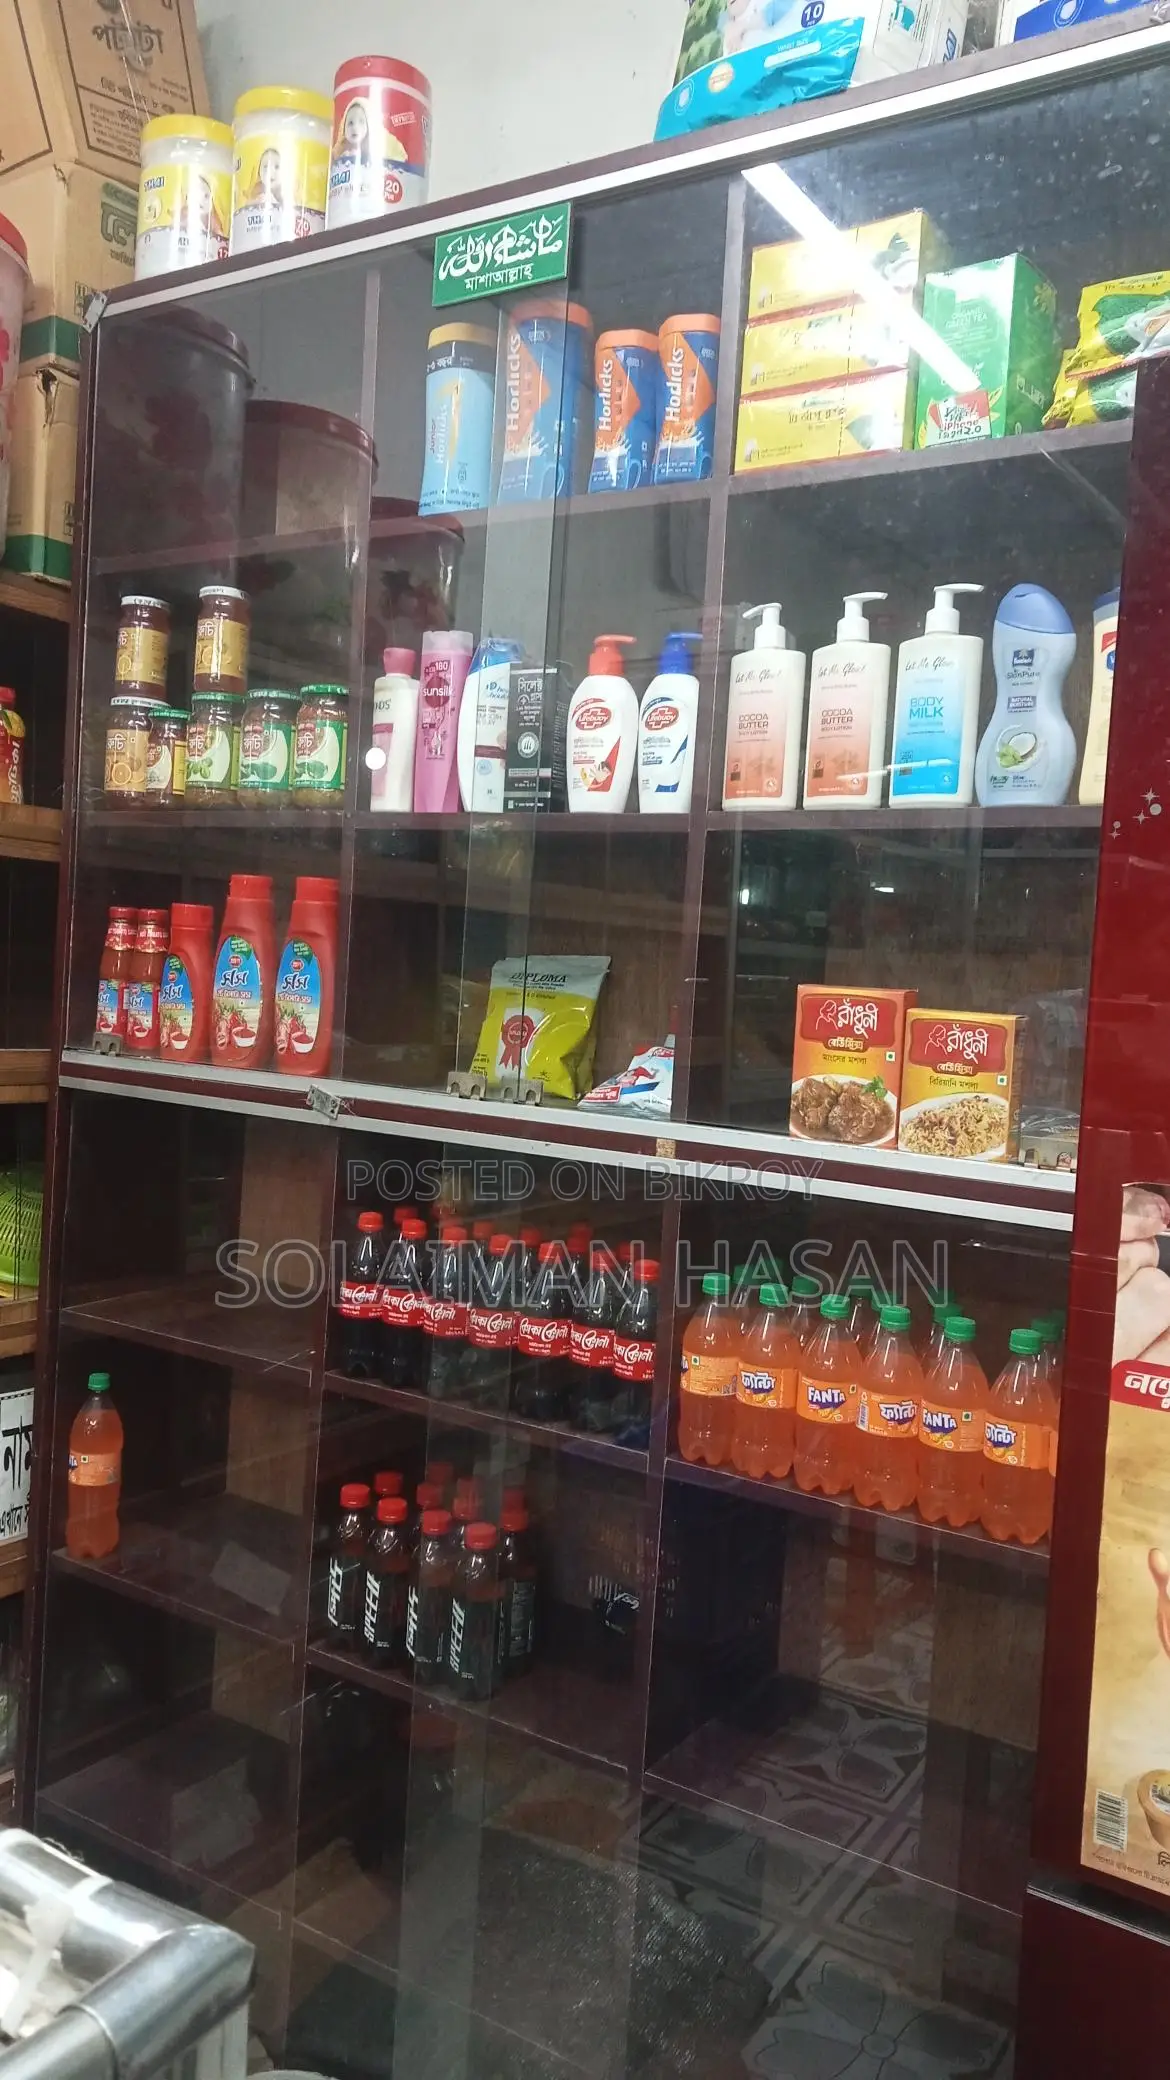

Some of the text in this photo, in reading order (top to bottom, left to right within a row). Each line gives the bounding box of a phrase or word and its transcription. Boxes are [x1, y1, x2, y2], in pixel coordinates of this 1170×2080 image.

[803, 5, 825, 22] 10
[505, 332, 522, 432] Horlicks
[664, 346, 685, 424] Horlicks
[598, 358, 614, 433] Horlicks
[910, 696, 944, 708] BODY
[578, 713, 609, 724] Lifebuoy
[647, 712, 677, 724] Lifebuoy
[739, 713, 769, 722] COCOA
[821, 707, 854, 718] COCOA
[909, 706, 945, 720] MILK
[738, 720, 769, 730] BUTTER
[821, 716, 854, 726] BUTTER
[511, 972, 568, 983] DIPLOMA
[807, 1386, 846, 1404] FANTA
[922, 1408, 958, 1429] FANTA
[363, 1569, 381, 1644] SPEED
[449, 1596, 466, 1674] SPEED
